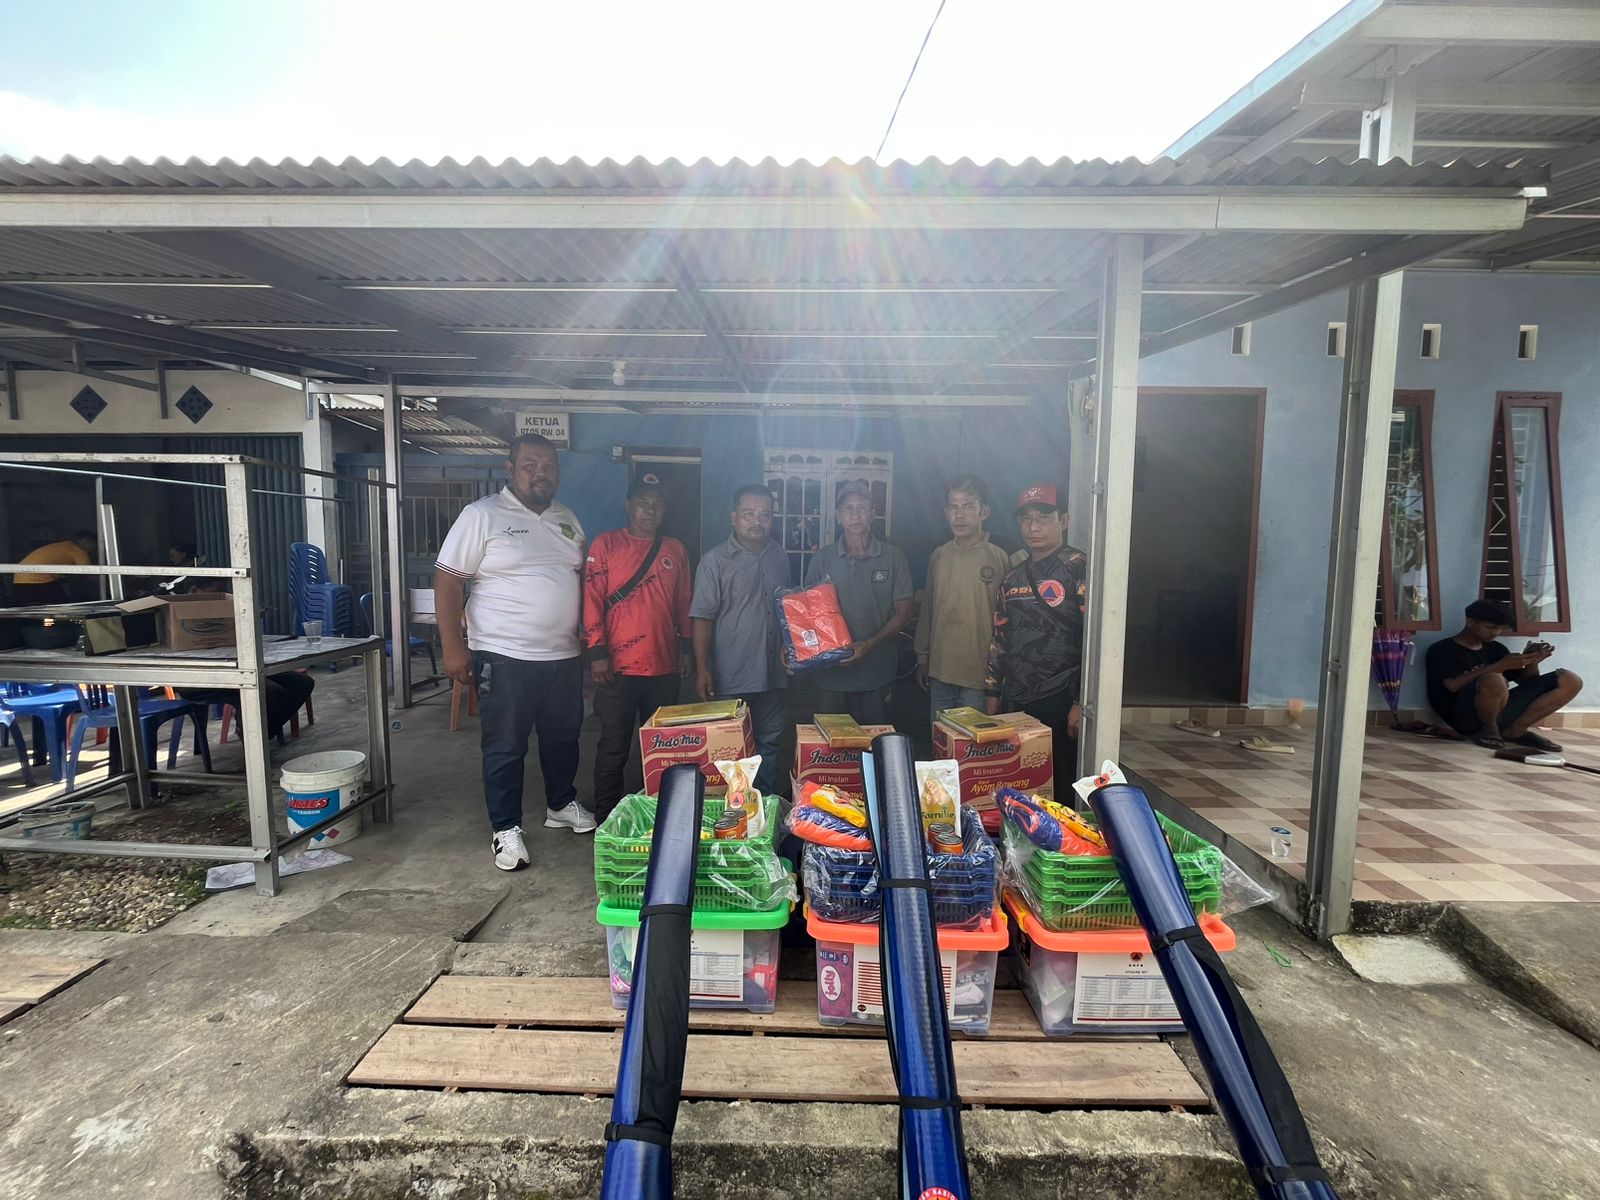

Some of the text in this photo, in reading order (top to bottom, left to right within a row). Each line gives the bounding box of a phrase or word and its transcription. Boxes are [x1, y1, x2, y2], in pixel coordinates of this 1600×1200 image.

[525, 416, 560, 426] KETUA
[818, 775, 849, 783] Mi Instan
[970, 779, 1030, 795] Ayam Bawang
